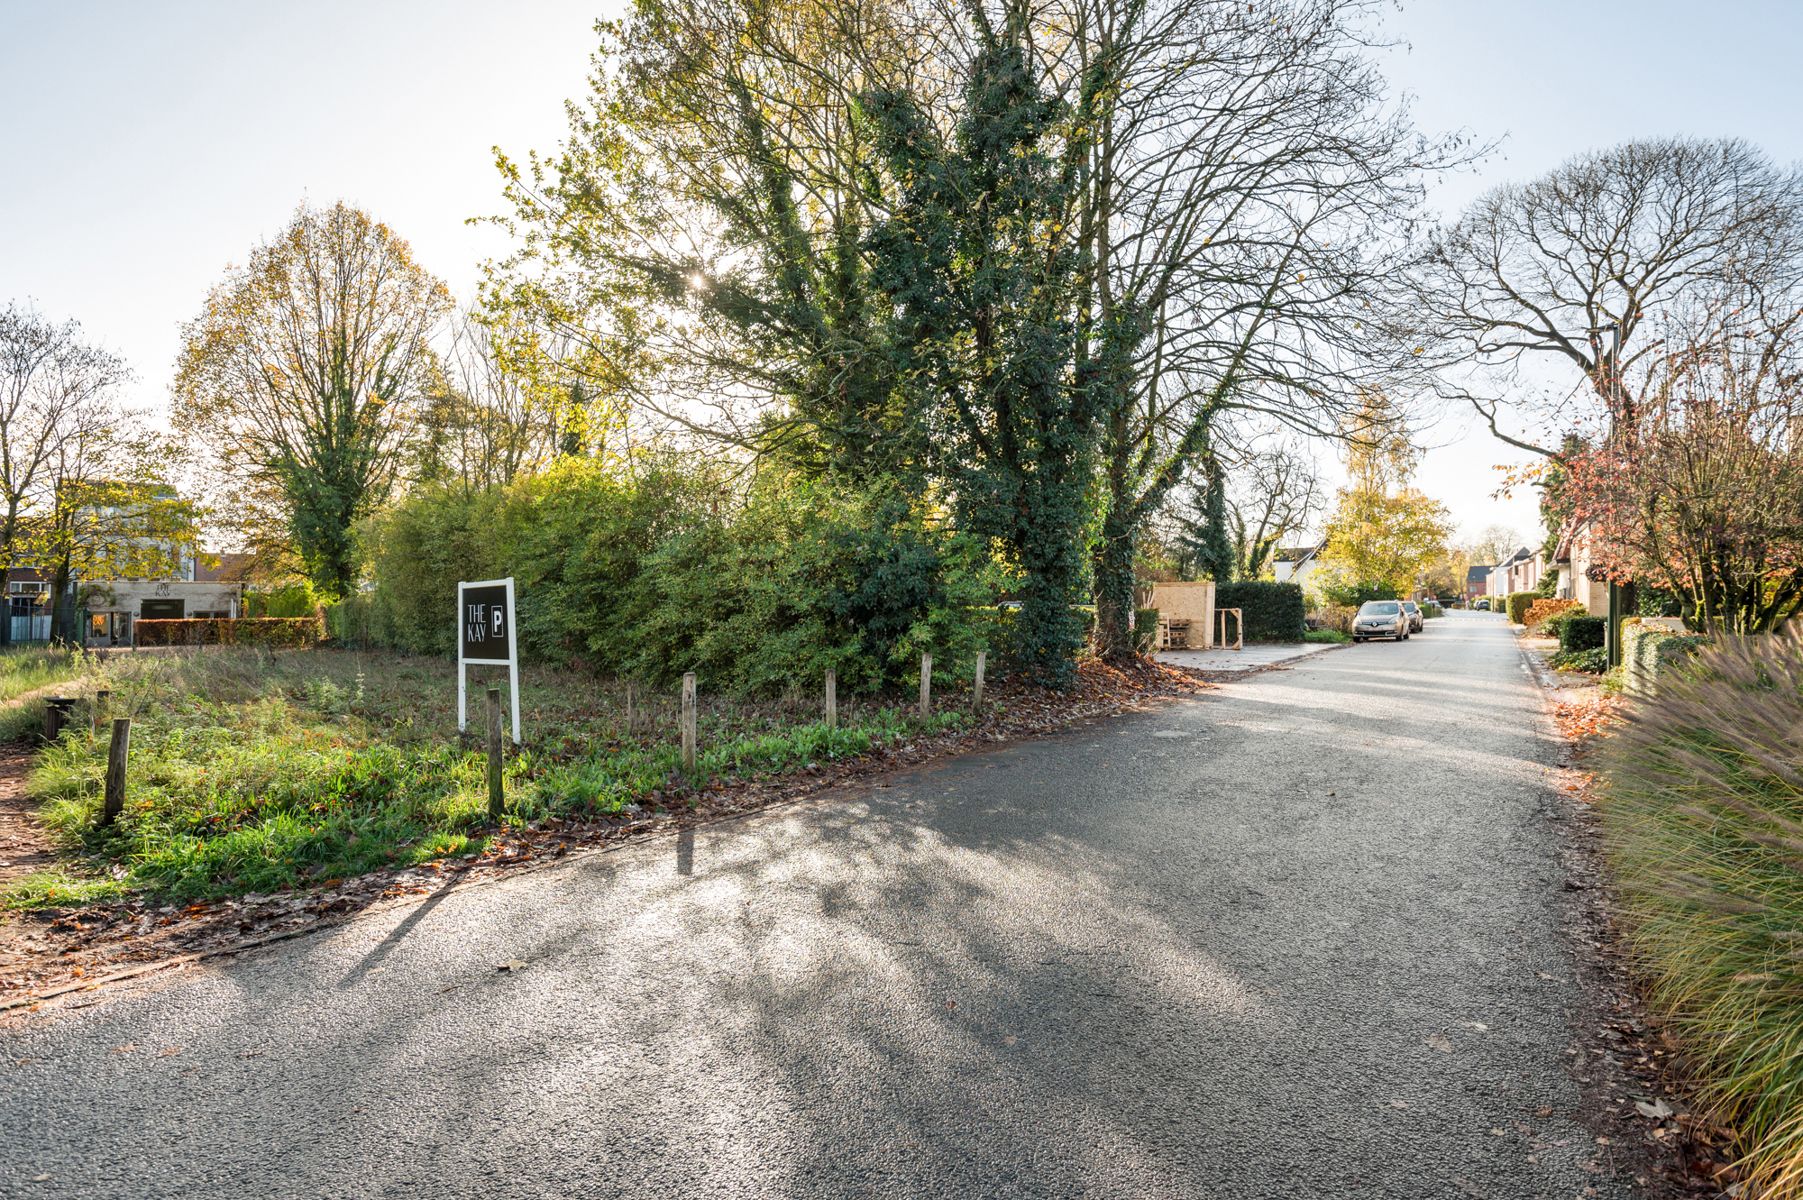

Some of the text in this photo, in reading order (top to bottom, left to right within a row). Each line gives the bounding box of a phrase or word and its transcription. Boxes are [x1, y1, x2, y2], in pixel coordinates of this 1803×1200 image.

[468, 604, 486, 623] THE
[494, 611, 502, 632] P
[468, 624, 486, 642] KAY
